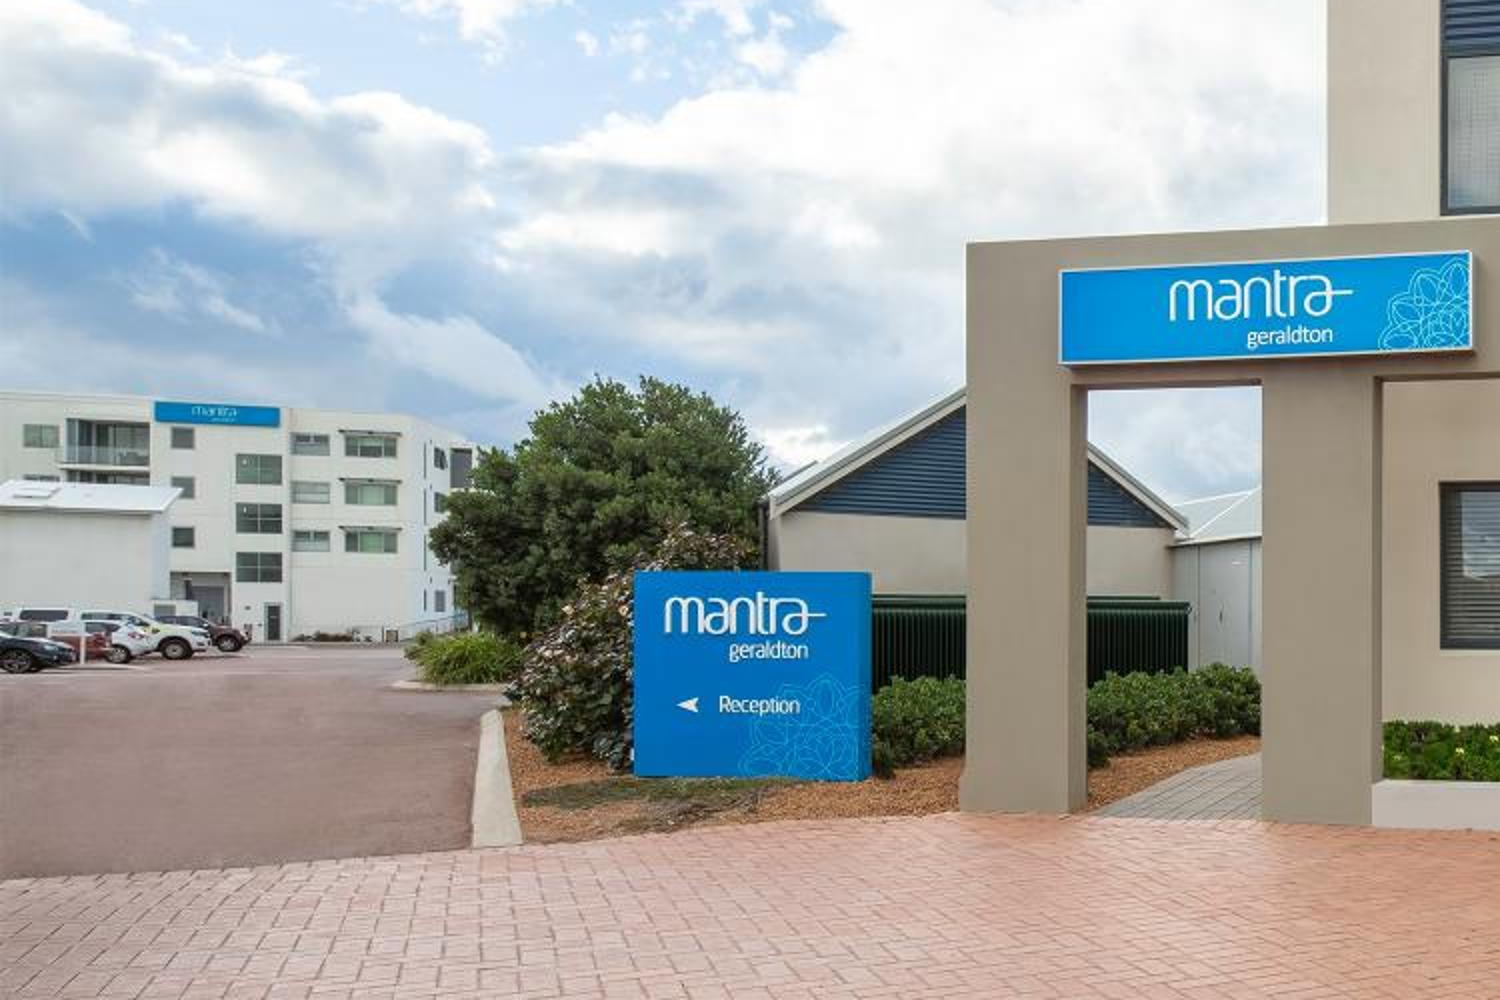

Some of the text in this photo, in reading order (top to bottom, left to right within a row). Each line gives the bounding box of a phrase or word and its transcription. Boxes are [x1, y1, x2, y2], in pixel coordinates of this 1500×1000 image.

[1168, 269, 1353, 321] mantra
[1247, 325, 1333, 349] geraldton
[664, 592, 827, 635] mantra
[729, 640, 808, 662] geraldton
[719, 695, 800, 717] Reception
